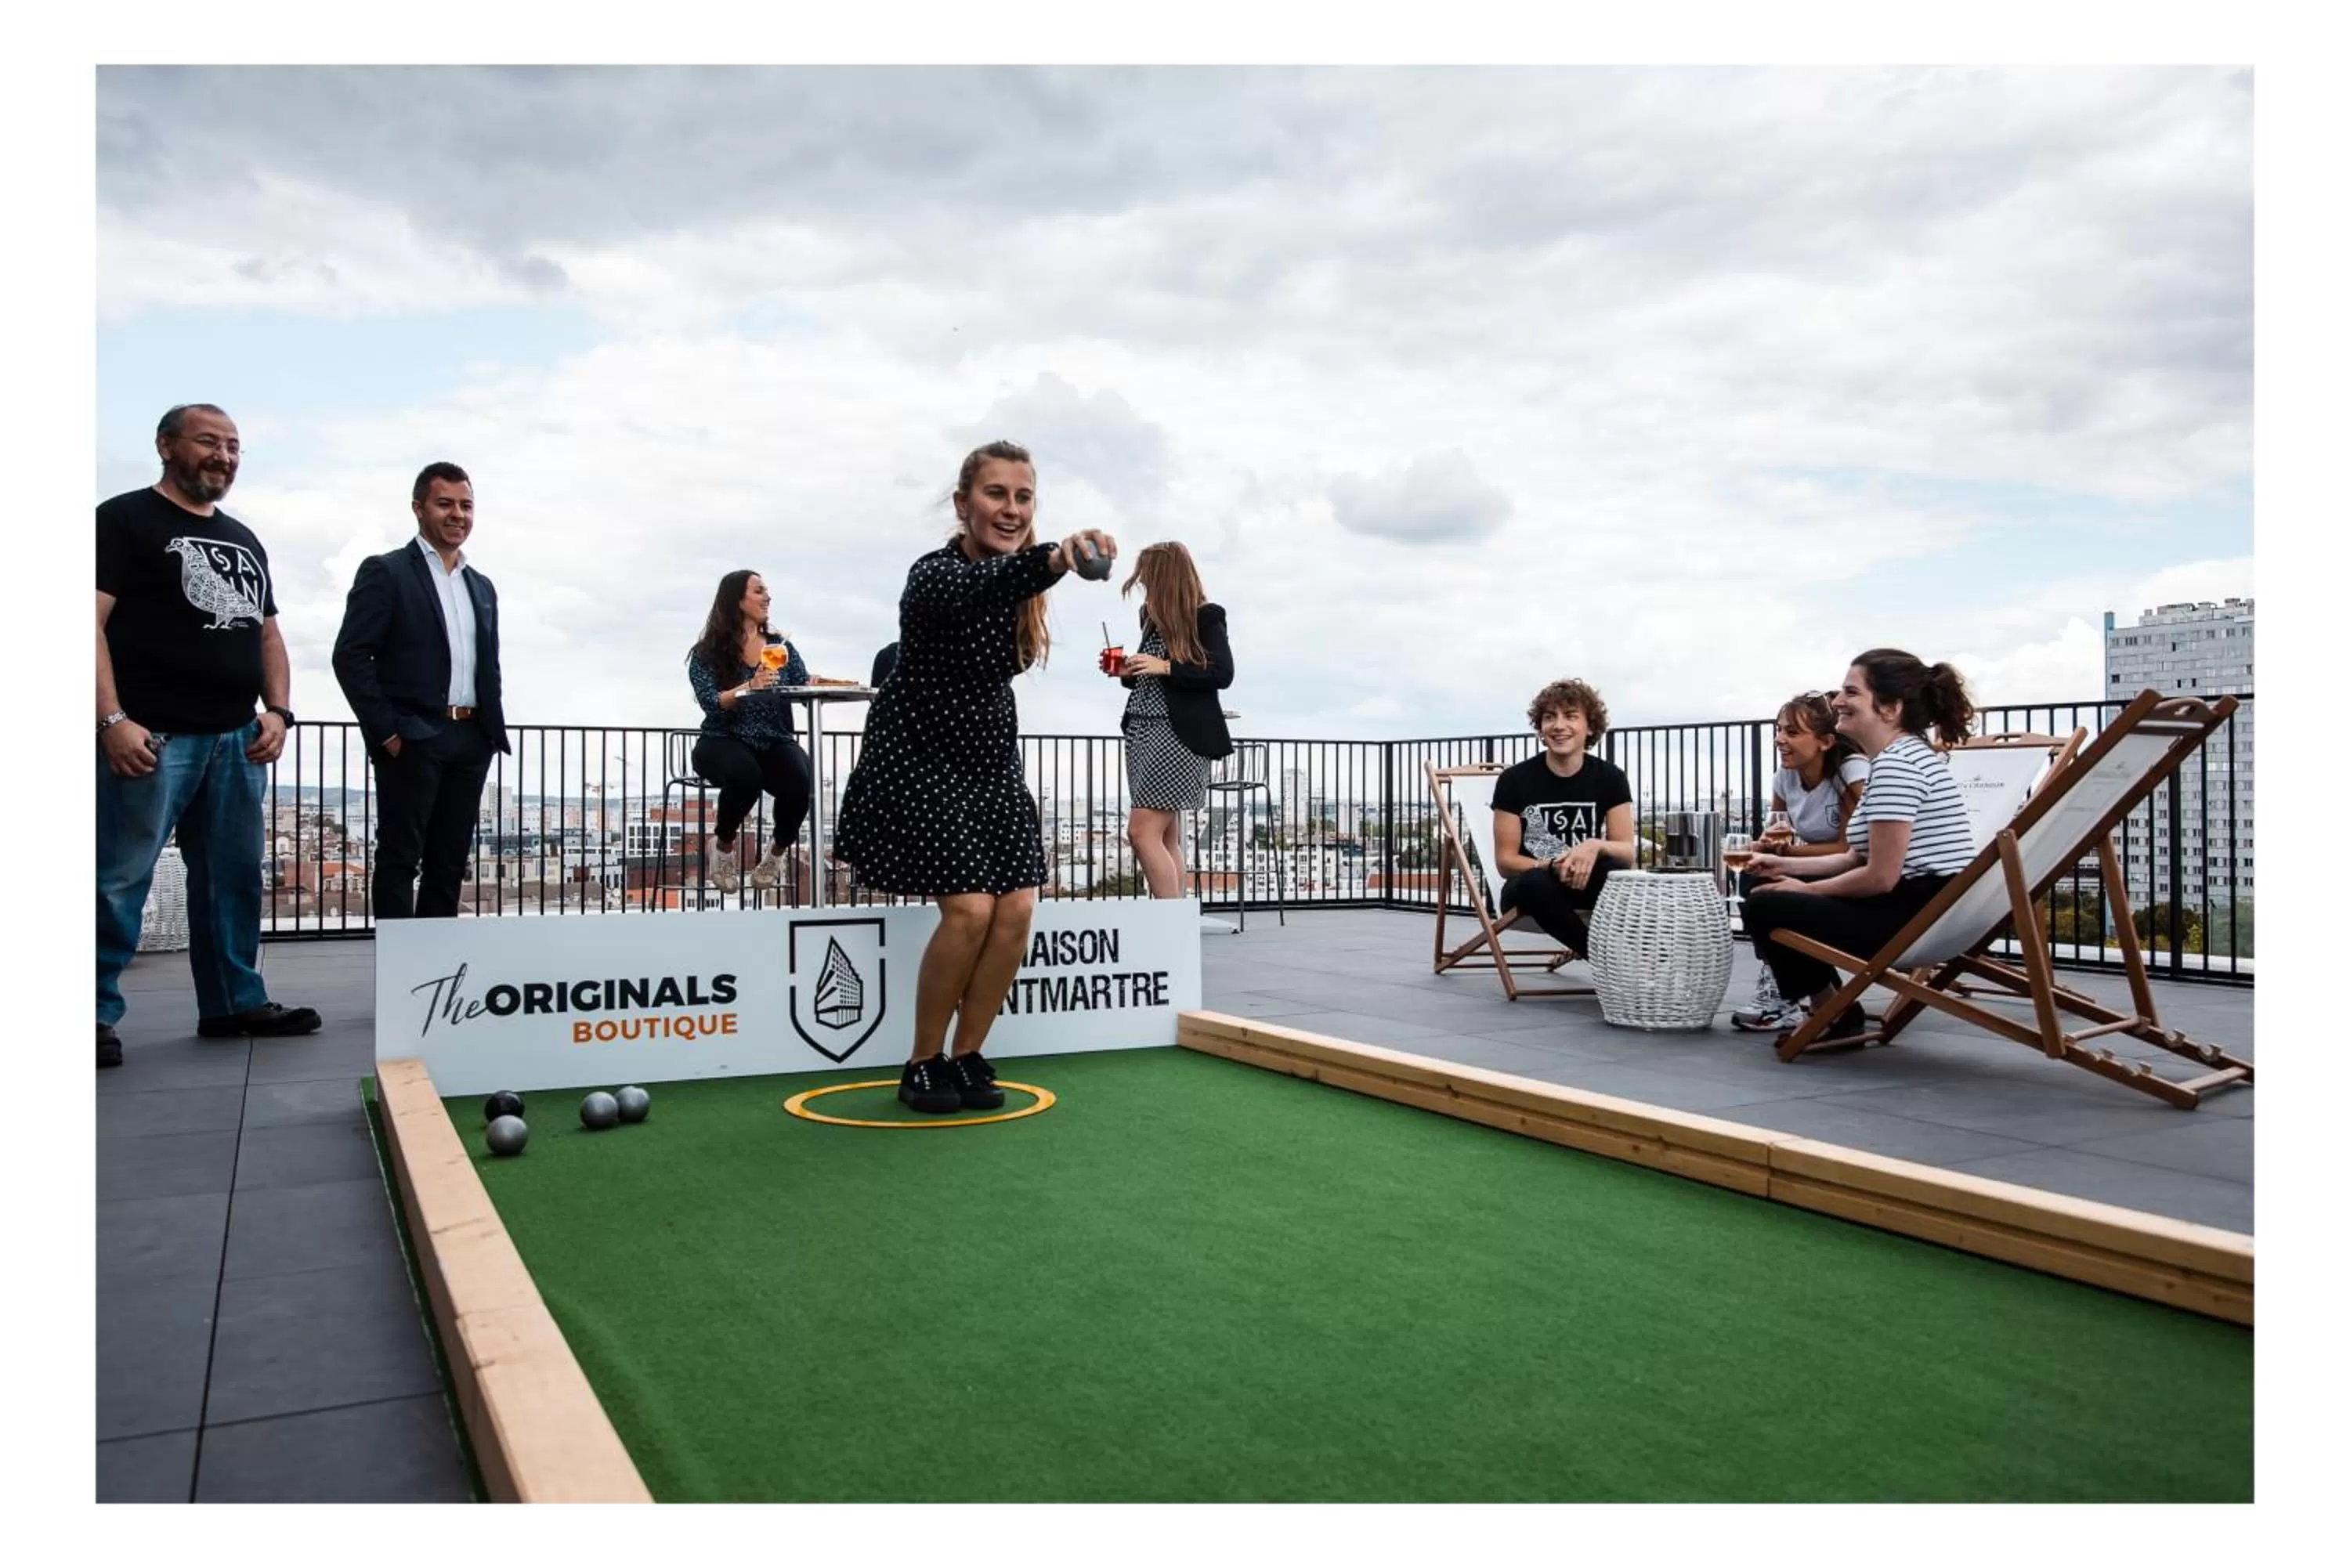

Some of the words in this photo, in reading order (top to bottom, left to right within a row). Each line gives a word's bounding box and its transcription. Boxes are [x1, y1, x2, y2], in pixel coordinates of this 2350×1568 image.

[1021, 929, 1119, 968] AISON
[997, 970, 1170, 1016] NTMARTRE
[573, 1013, 739, 1043] BOUTIQUE
